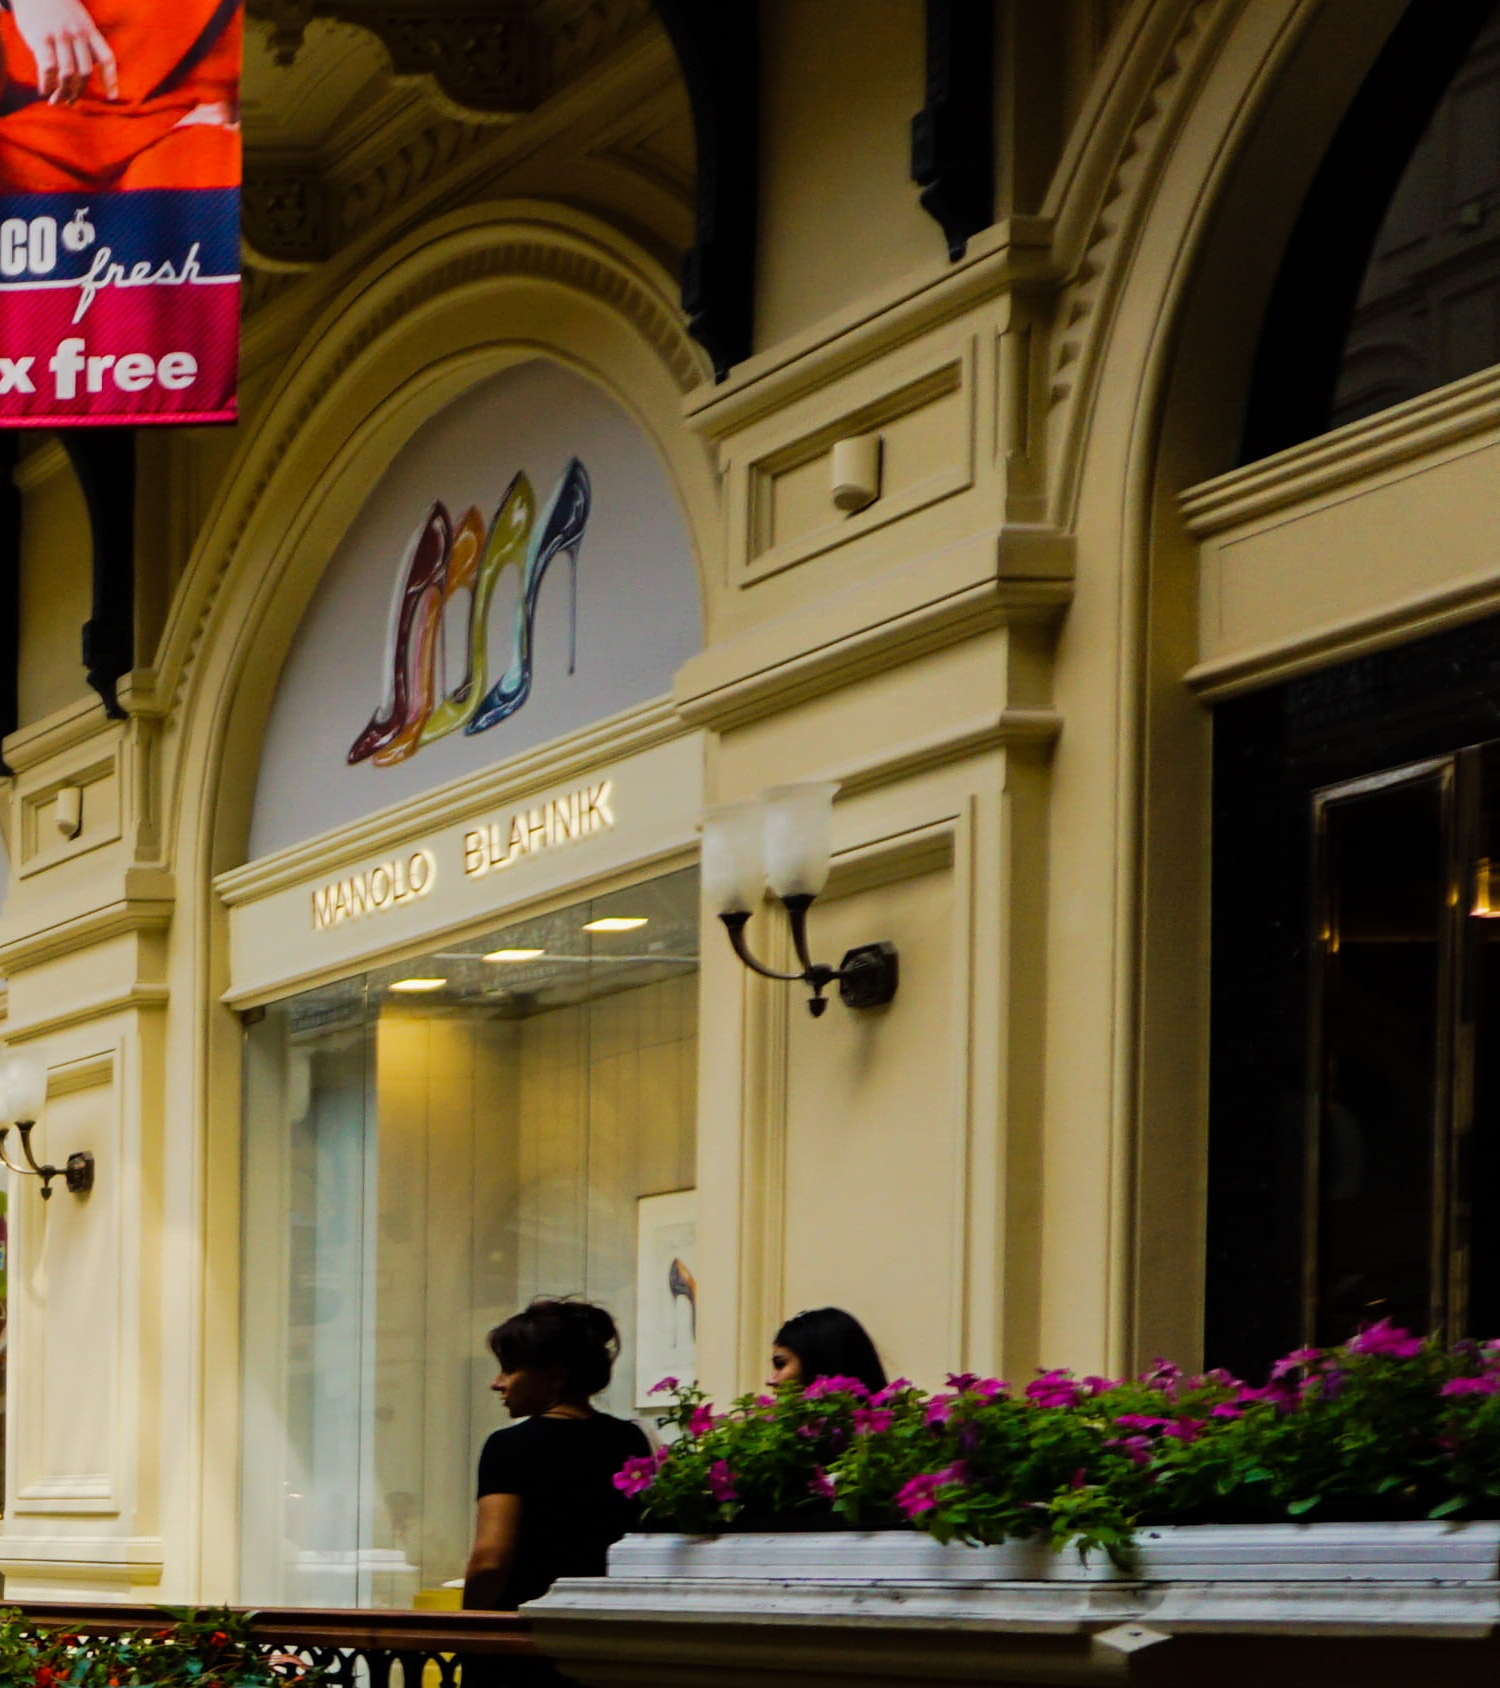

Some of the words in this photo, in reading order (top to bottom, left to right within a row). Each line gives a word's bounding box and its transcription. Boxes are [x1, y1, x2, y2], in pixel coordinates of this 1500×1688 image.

[72, 242, 200, 324] fresh
[49, 337, 198, 400] free
[311, 848, 437, 932] MANOLO
[463, 781, 616, 880] BLAHNIK
